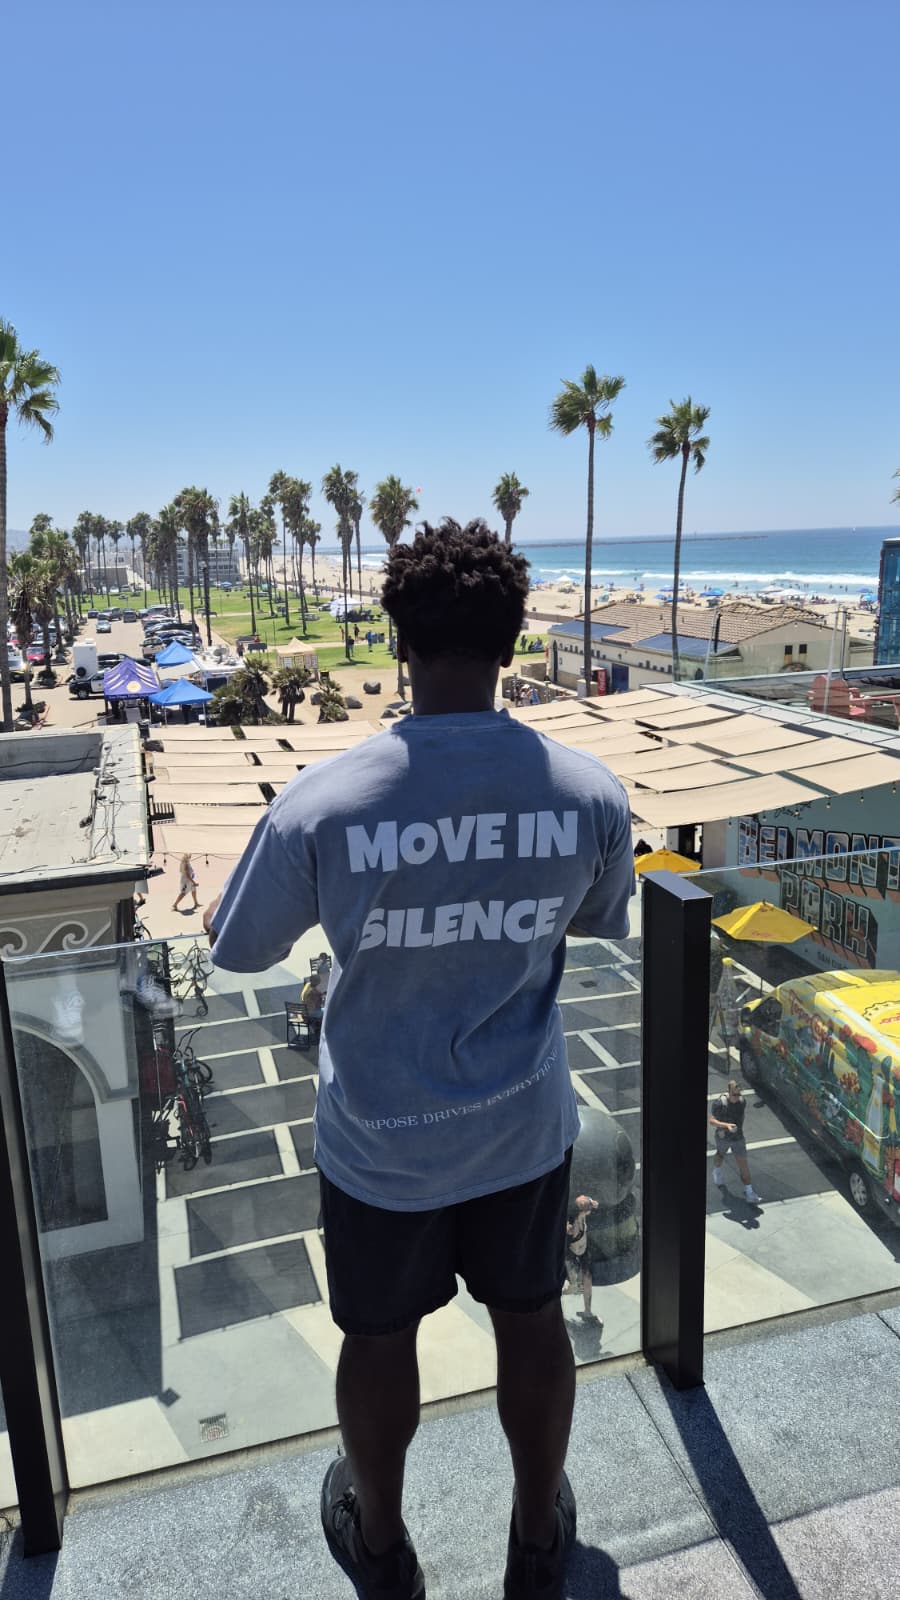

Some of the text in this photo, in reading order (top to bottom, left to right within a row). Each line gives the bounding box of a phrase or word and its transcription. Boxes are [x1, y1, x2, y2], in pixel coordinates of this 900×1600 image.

[345, 810, 579, 873] MOVE IN
[358, 896, 564, 952] SILENCE
[780, 868, 872, 960] PARK
[423, 1102, 481, 1125] DRIVES
[487, 1047, 559, 1106] EVERYTHING
